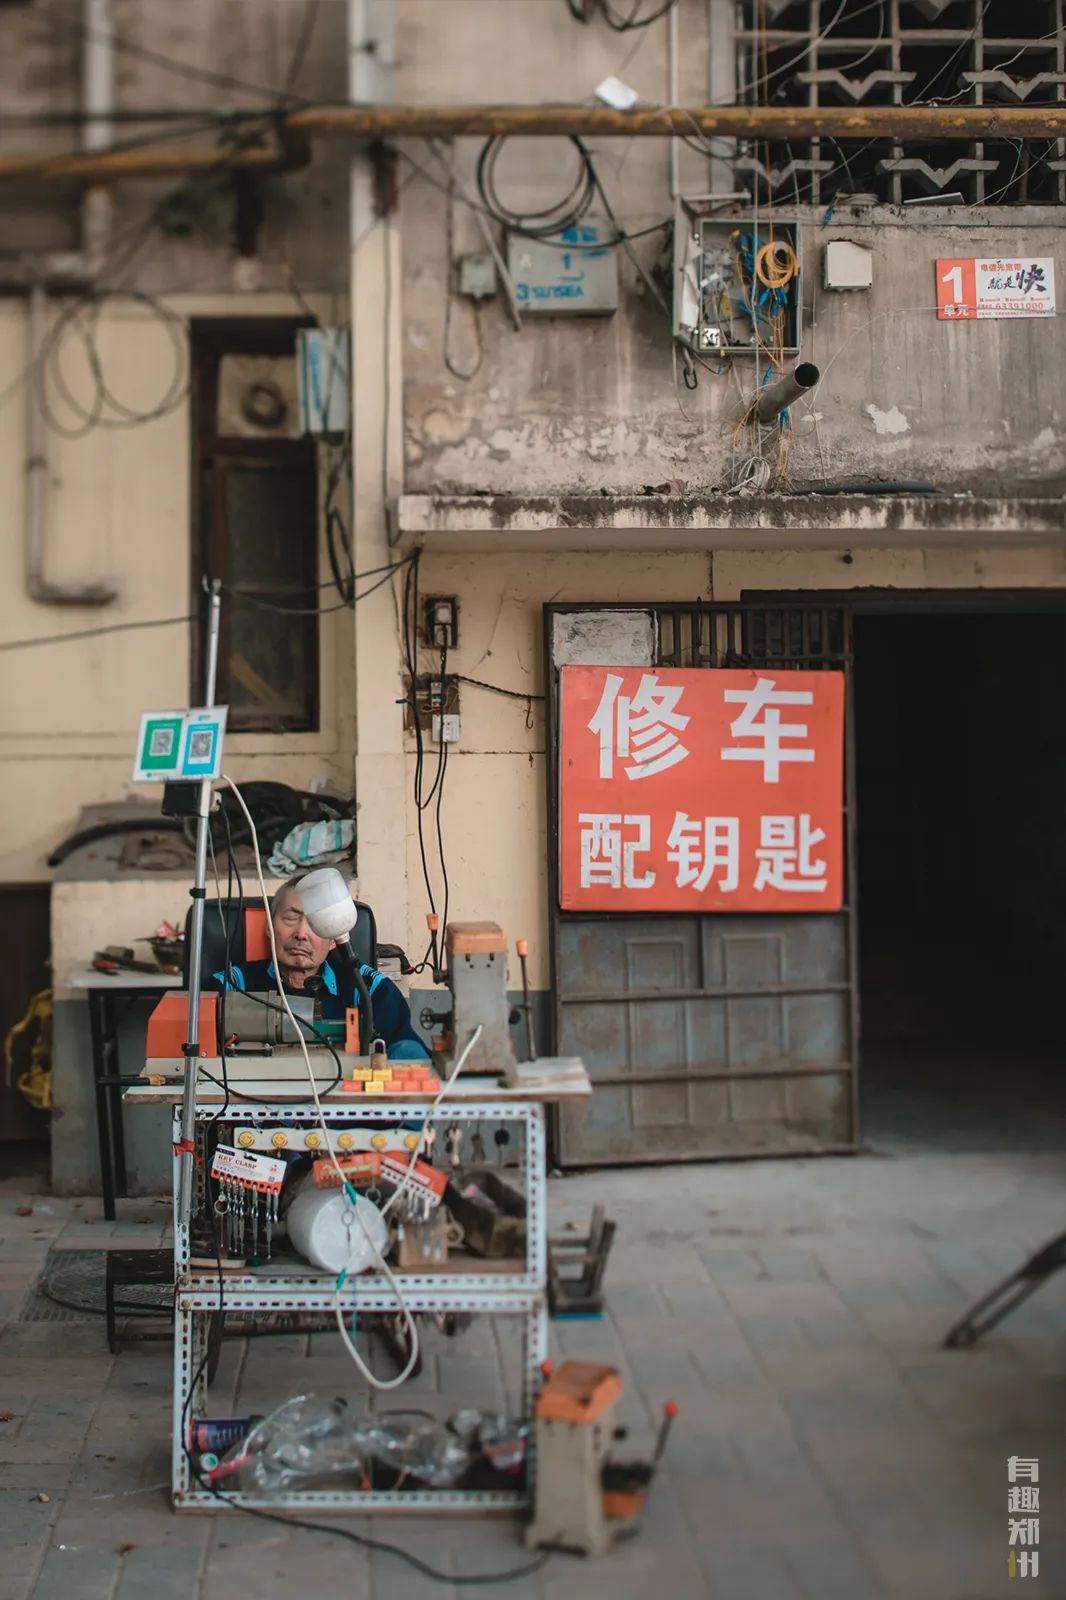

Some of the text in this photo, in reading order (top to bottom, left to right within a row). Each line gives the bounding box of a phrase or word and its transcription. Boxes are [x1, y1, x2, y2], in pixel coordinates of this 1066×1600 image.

[942, 266, 963, 304] 1
[988, 264, 1047, 295] 就是快
[943, 304, 969, 317] 单元
[587, 673, 815, 784] 修车
[578, 811, 828, 892] 配钥匙
[218, 1154, 257, 1169] KEY CLASP
